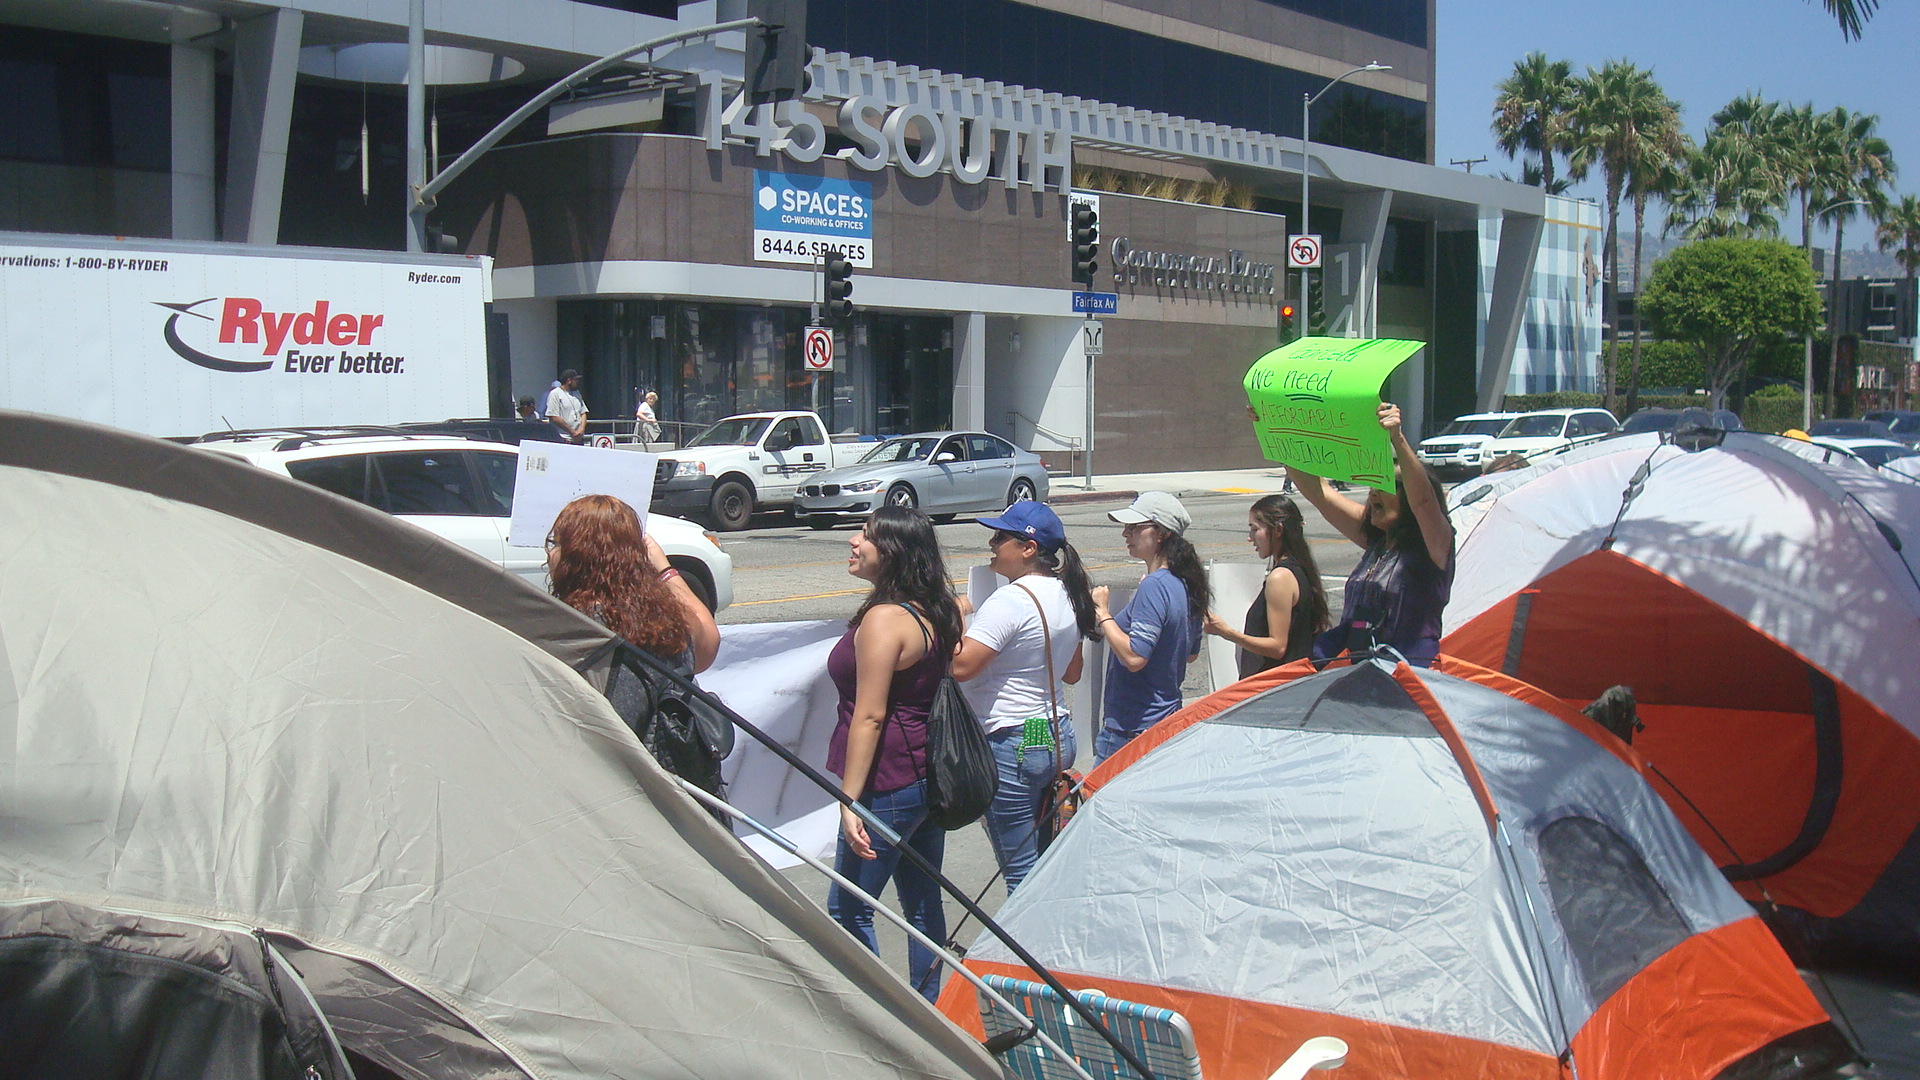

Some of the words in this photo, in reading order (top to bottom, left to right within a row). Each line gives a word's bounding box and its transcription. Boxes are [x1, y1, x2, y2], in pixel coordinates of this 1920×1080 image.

[698, 70, 826, 163] 145
[839, 96, 1072, 195] SOUTH
[781, 188, 868, 219] SPACES.
[781, 214, 828, 227] CO-WORKING
[834, 220, 864, 230] OFFICES
[762, 237, 865, 260] 844.6.SPACES
[65, 256, 169, 272] 1-800-BY-RYDER
[408, 271, 461, 284] Ryder.com
[1075, 295, 1103, 309] Fairfax
[1104, 297, 1115, 309] Av
[218, 297, 384, 356] Ryder
[285, 350, 334, 373] Ever
[338, 351, 405, 374] better.
[1251, 368, 1275, 390] We
[1283, 369, 1333, 394] need
[1261, 400, 1350, 430] AFFORDABLE
[1264, 436, 1339, 471] HOUSING
[1346, 438, 1390, 482] NOW!
